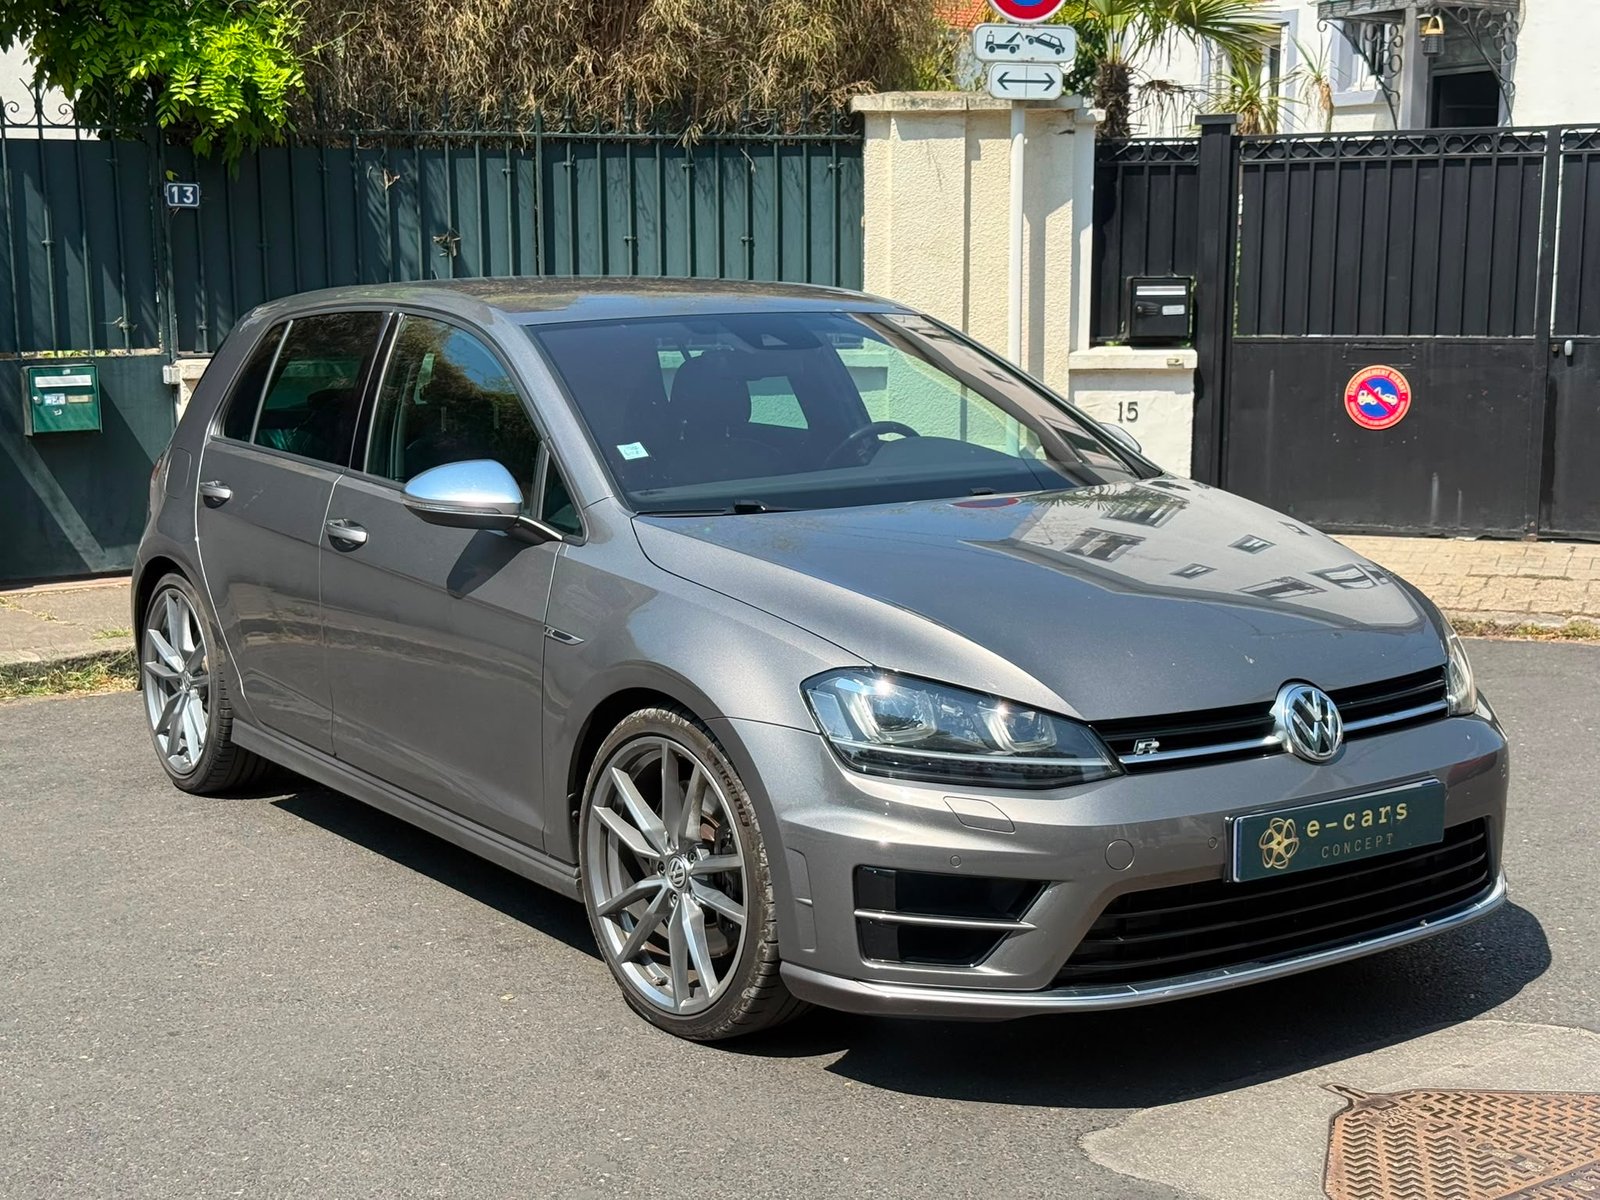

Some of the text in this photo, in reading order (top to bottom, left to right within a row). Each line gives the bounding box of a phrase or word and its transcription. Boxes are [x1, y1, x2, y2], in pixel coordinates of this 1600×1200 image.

[171, 186, 194, 204] 13
[1117, 401, 1139, 424] 15
[1305, 802, 1408, 838] e-cars
[1321, 833, 1394, 858] CONCEPT
